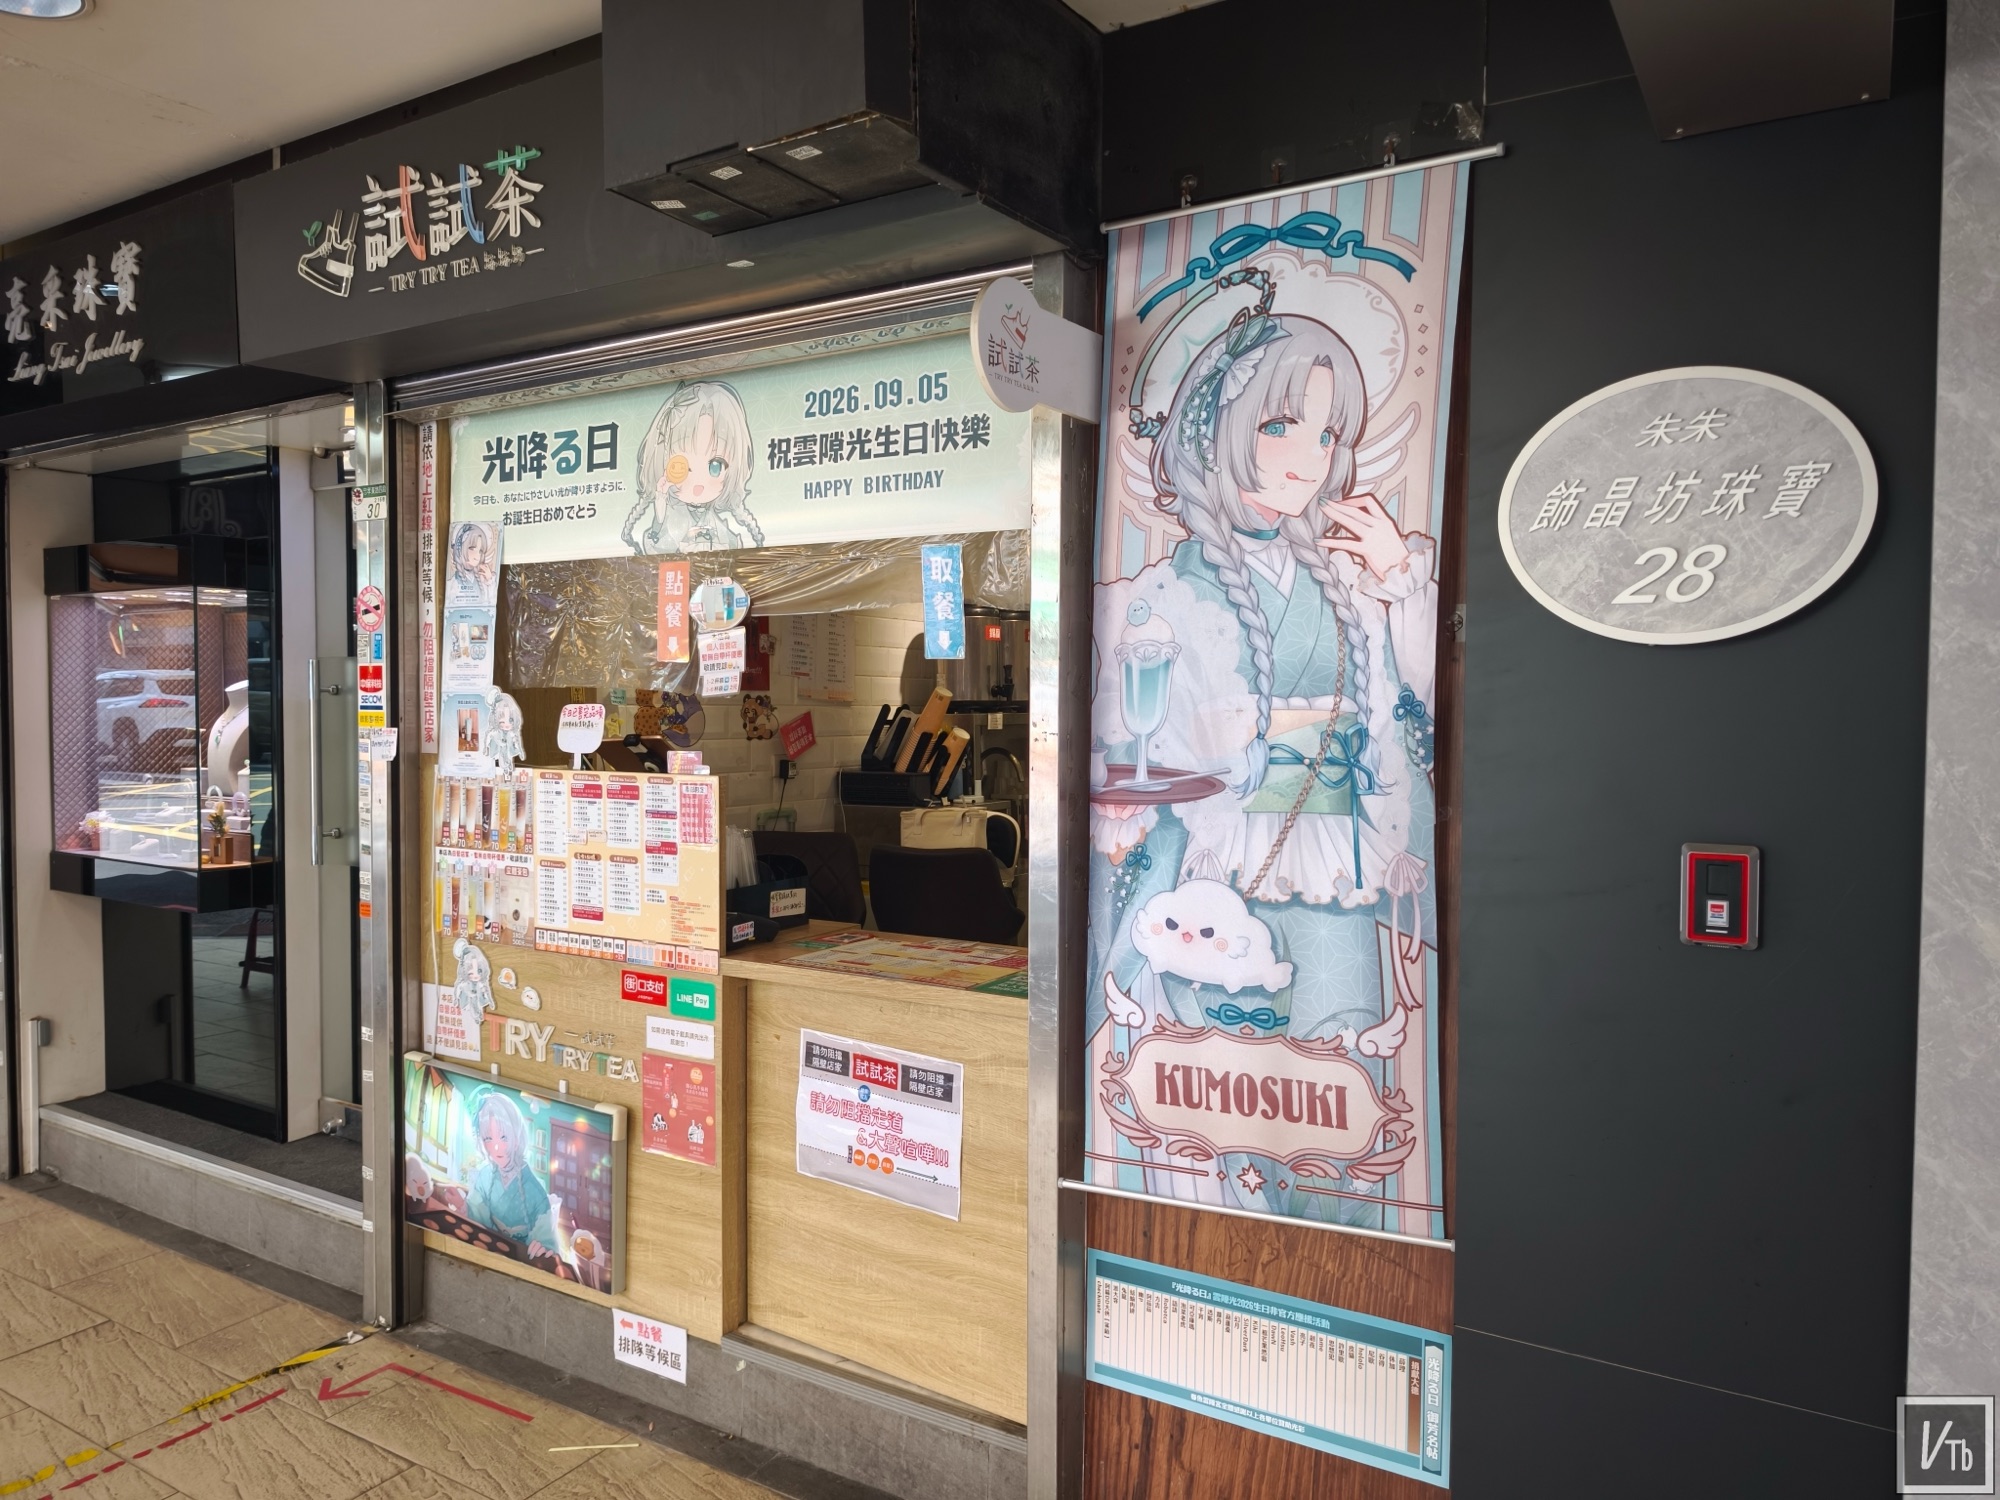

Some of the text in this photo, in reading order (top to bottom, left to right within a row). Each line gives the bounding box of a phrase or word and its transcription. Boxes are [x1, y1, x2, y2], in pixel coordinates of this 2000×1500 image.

[361, 145, 544, 272] 試試茶
[389, 270, 417, 293] TRY
[419, 263, 448, 286] TRY
[450, 256, 481, 278] TEA
[988, 333, 1040, 384] 試試茶
[804, 371, 949, 418] 2026.09.05
[767, 413, 991, 471] 祝雲隙光生日快樂
[1636, 407, 1729, 448] 朱朱
[482, 421, 620, 485] 光降る日
[803, 469, 945, 500] HAPPY BIRTHDAY
[1529, 460, 1834, 533] 飾晶坊珠寶
[367, 503, 381, 518] 30
[502, 502, 597, 527] お誕生日おめでとう
[930, 556, 954, 621] 取餐
[1611, 543, 1727, 605] 28
[665, 570, 683, 628] 點餐
[361, 695, 382, 704] SECOM
[624, 973, 664, 995] 街口支付
[676, 993, 709, 1007] LINE Pay
[483, 1012, 556, 1062] TRY
[812, 1044, 843, 1061] 請勿阻擋
[552, 1043, 594, 1072] TRY
[595, 1051, 640, 1083] TEA
[811, 1058, 842, 1073] 隔壁店家
[855, 1058, 897, 1085] 試試茶
[909, 1068, 945, 1085] 請勿阻擋
[908, 1082, 944, 1098] 隔壁店家
[1154, 1061, 1349, 1131] KUMOSUKI
[810, 1090, 904, 1134] 請勿阻擋走道
[637, 1321, 662, 1343] 點餐
[618, 1335, 682, 1371] 排隊等候區
[1427, 1358, 1440, 1407] 光降る日
